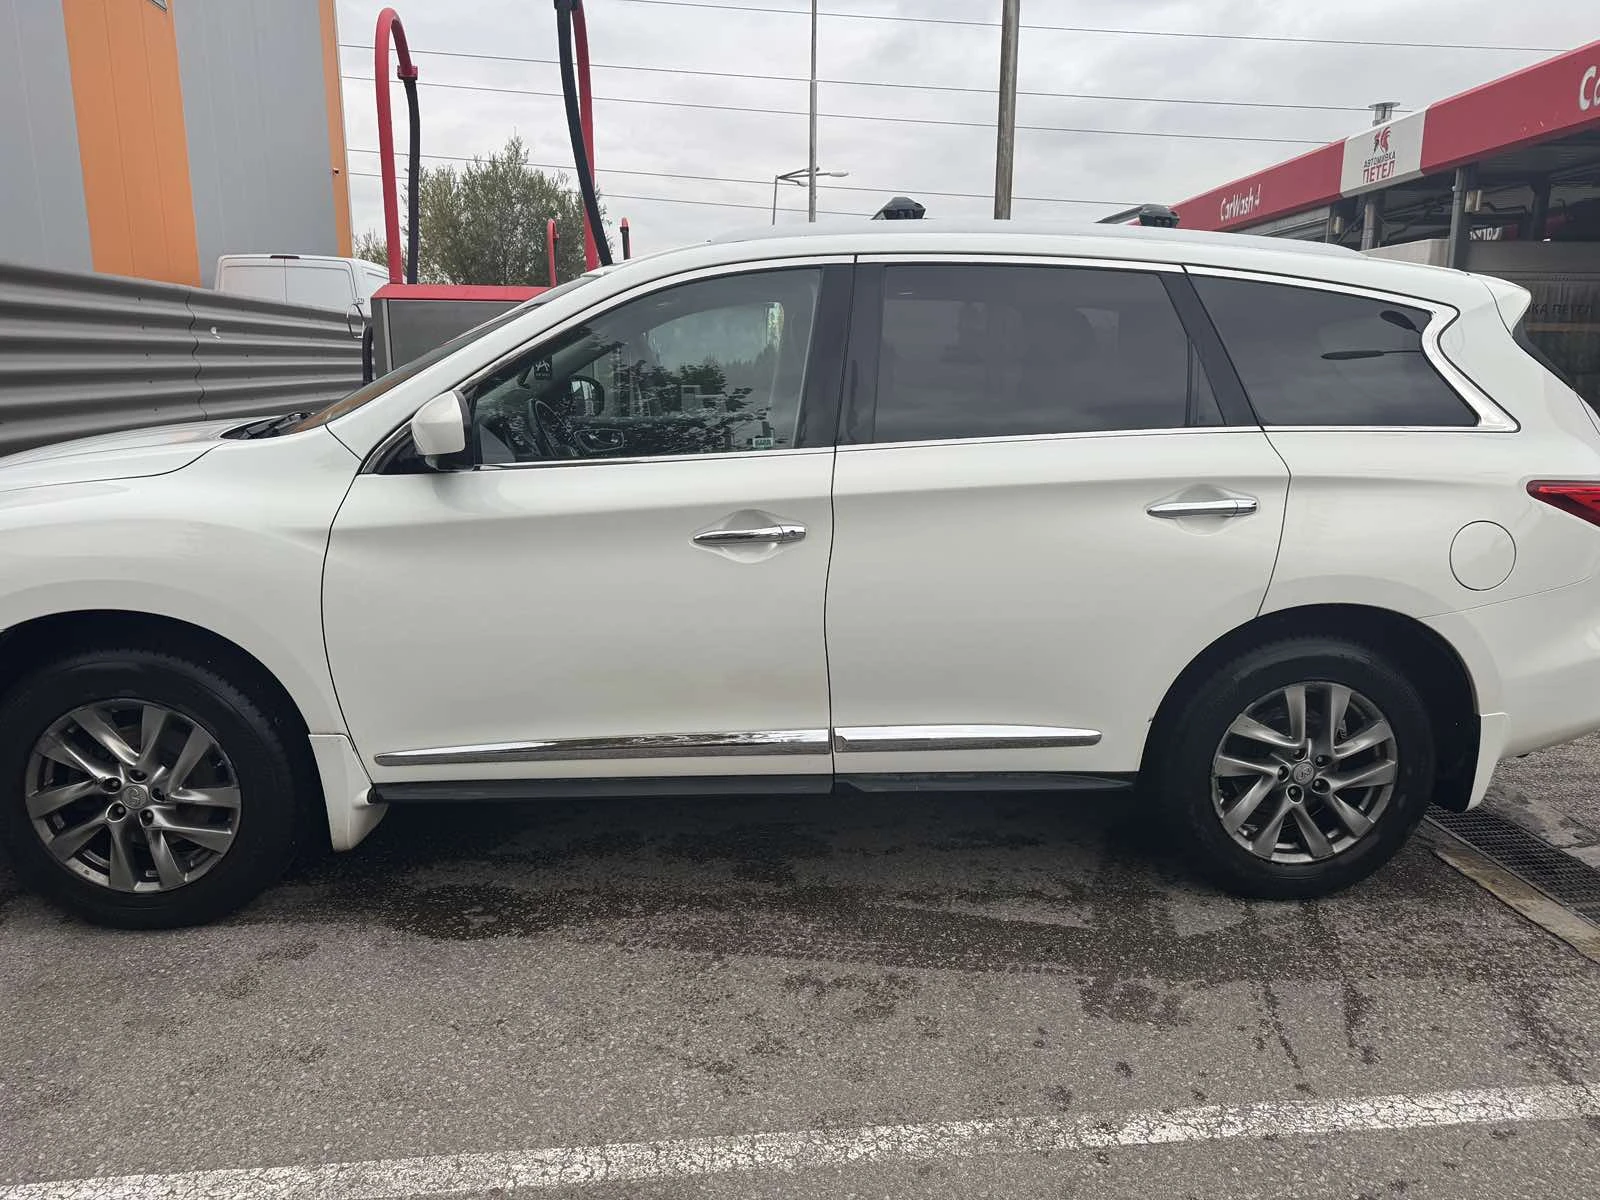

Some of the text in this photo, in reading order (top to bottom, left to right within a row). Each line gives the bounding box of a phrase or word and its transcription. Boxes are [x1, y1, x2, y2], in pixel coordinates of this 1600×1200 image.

[1362, 160, 1396, 185] ПЕТЕЛ
[1220, 187, 1254, 221] CarWash
[1528, 303, 1548, 314] КА
